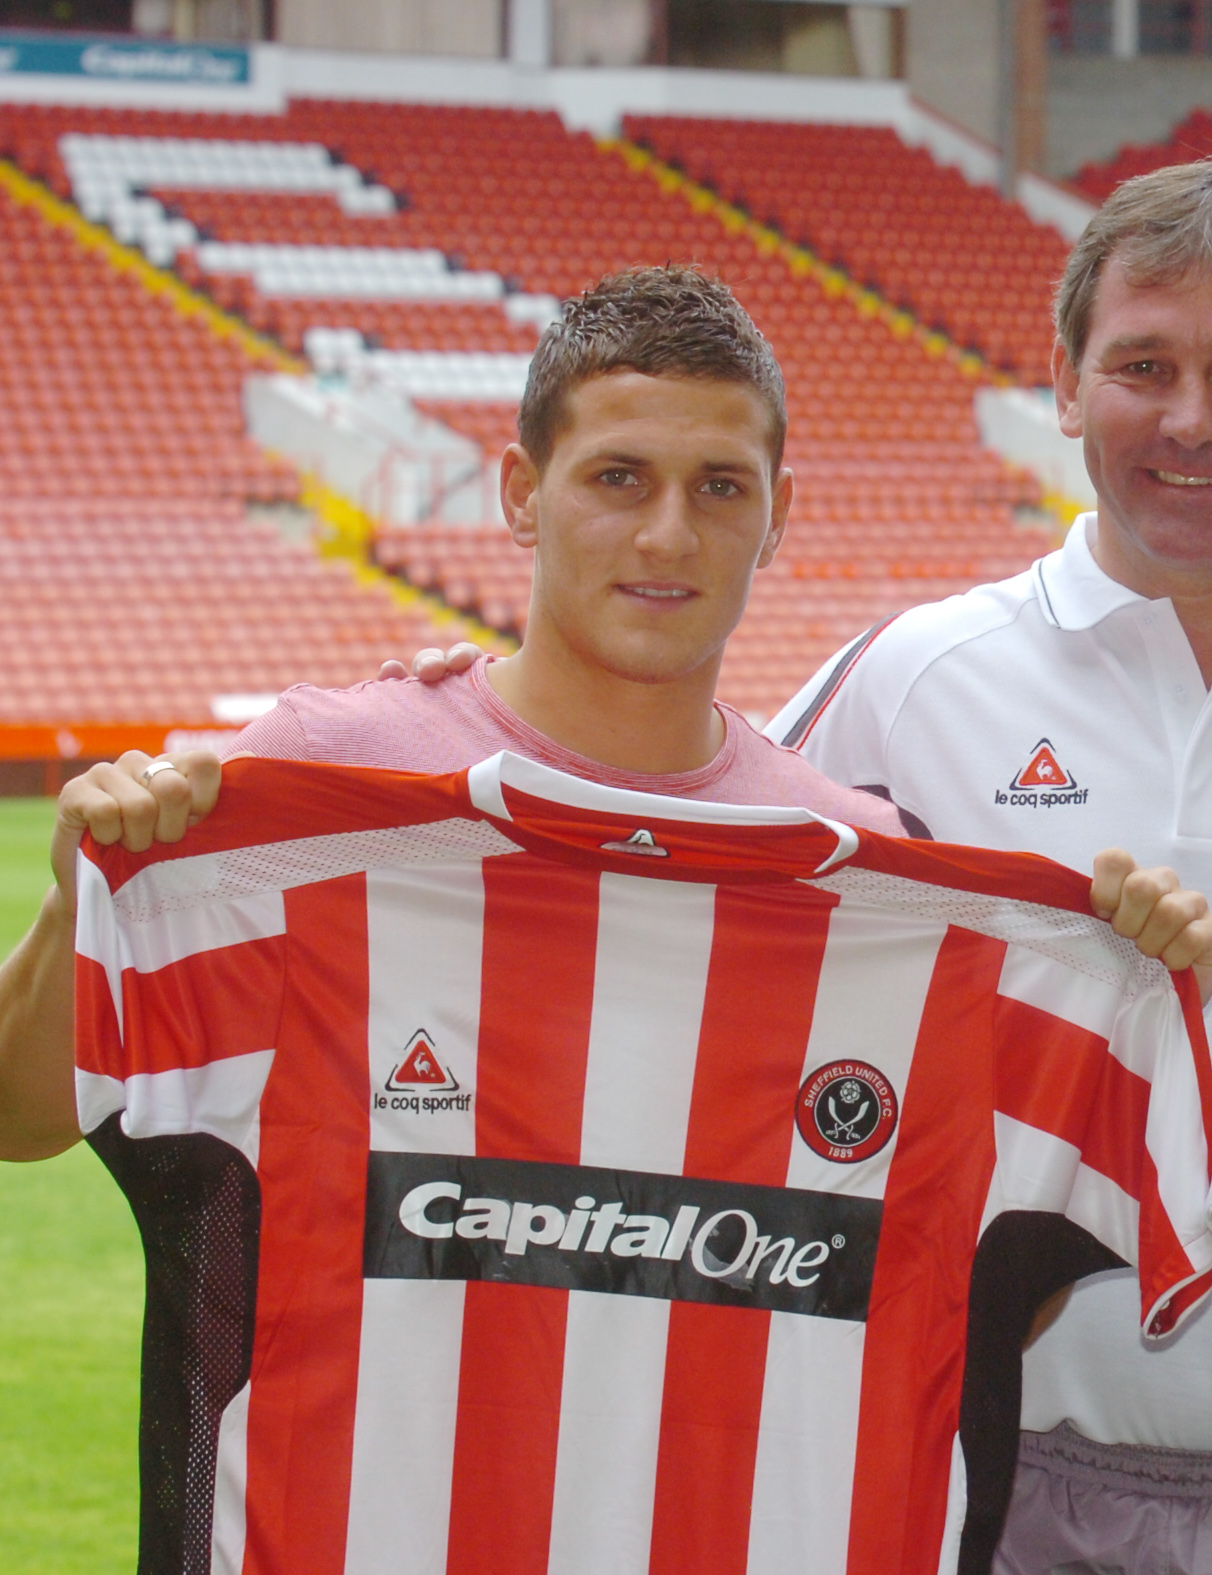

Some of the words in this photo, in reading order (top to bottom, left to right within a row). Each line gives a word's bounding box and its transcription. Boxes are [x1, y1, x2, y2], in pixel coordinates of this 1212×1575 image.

[994, 789, 1008, 805] le
[1010, 793, 1038, 809] coq
[1039, 788, 1089, 809] sportif
[804, 1065, 853, 1108] SHEFFIELD
[854, 1066, 888, 1096] UNITED
[374, 1093, 388, 1110] le
[391, 1097, 420, 1115] coq
[421, 1093, 472, 1115] sportif
[828, 1146, 853, 1159] 1889
